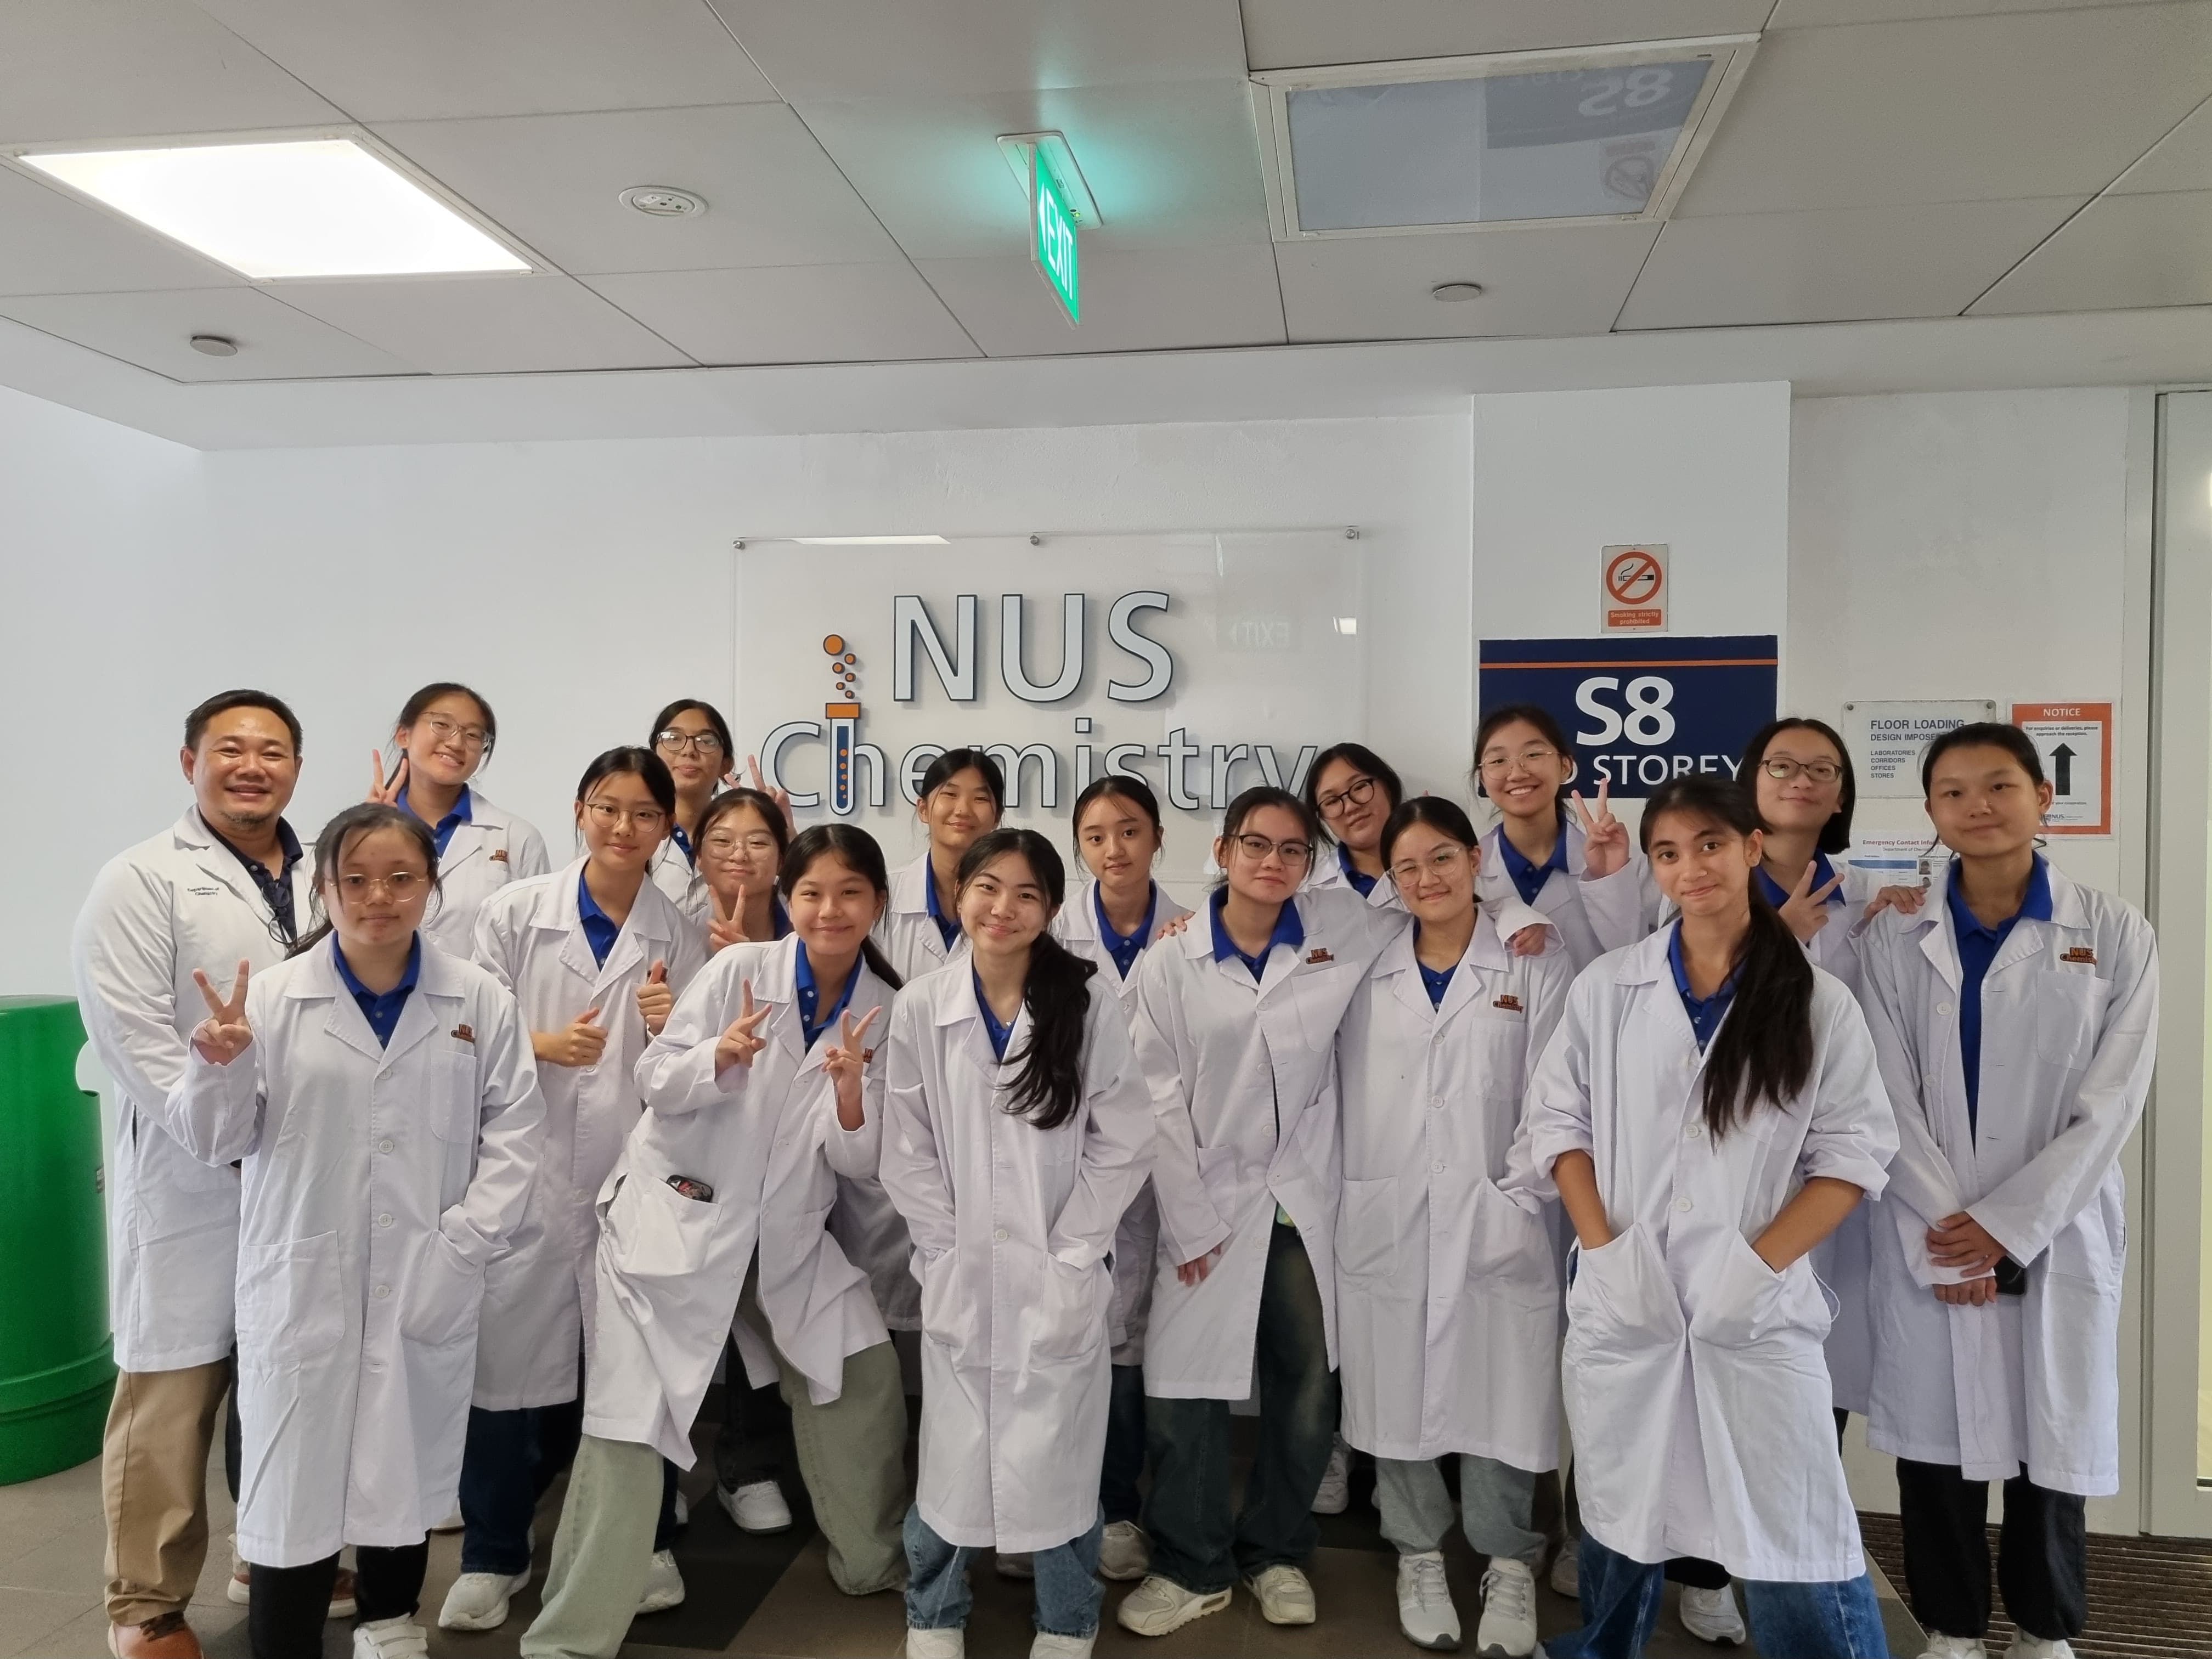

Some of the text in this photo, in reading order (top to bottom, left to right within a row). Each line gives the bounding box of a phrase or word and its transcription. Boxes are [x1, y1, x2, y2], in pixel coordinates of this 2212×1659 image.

[1046, 188, 1073, 300] EXIT
[894, 590, 1173, 702] NUS
[1576, 676, 1675, 746] S8
[2043, 708, 2081, 716] NOTICE
[1870, 720, 1965, 730] FLOOR LOADING
[2069, 947, 2093, 957] NUS
[1500, 994, 1519, 1005] NUS
